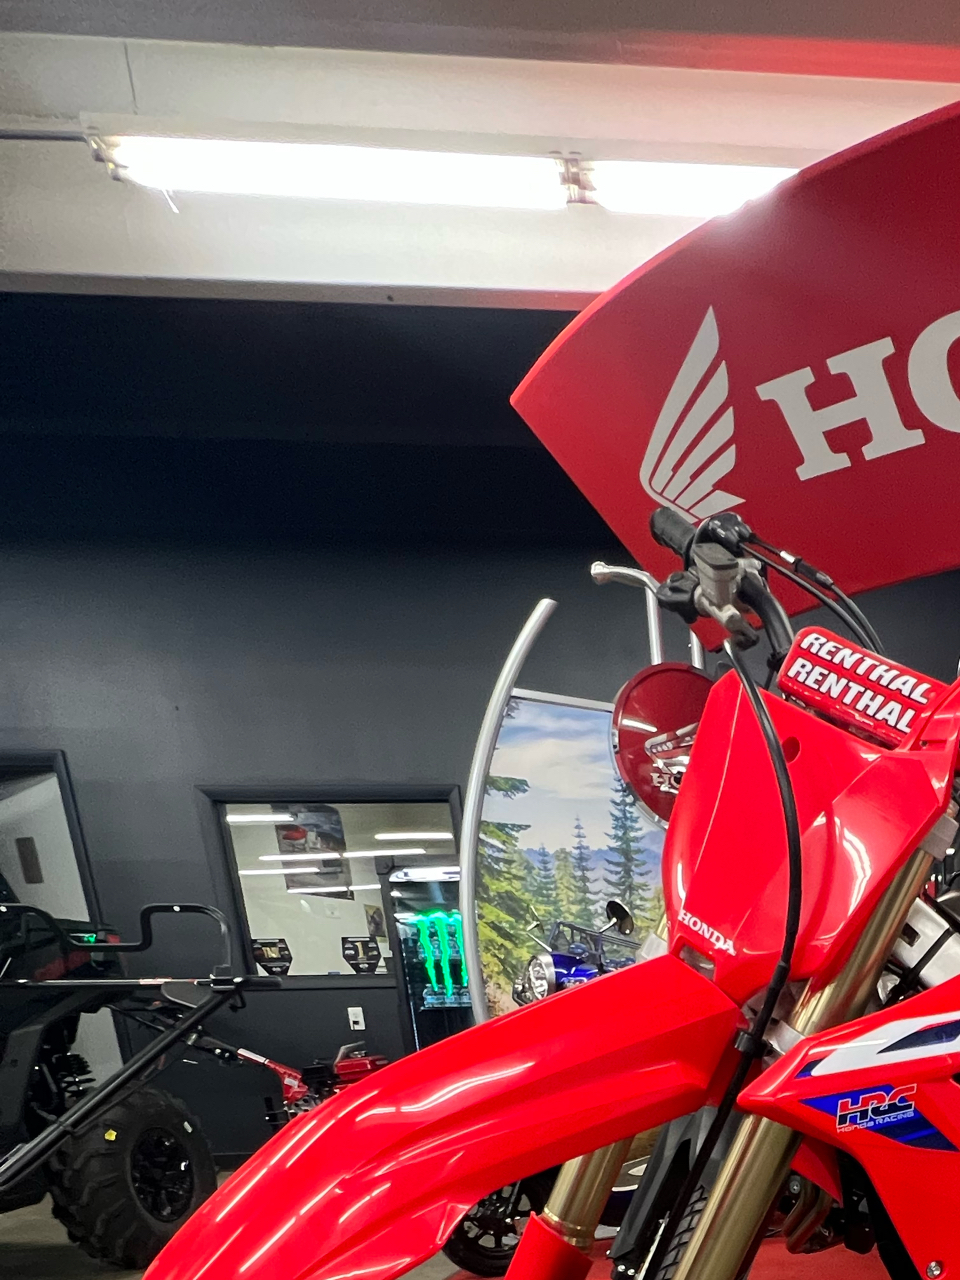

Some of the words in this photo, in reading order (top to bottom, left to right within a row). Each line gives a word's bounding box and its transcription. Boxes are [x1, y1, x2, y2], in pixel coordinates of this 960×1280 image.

[800, 632, 932, 705] RENTHAL
[786, 656, 916, 734] RENTHAL
[677, 908, 737, 957] HONDA
[836, 1083, 917, 1127] HRC
[837, 1121, 875, 1133] Honda
[875, 1111, 915, 1125] RACING
